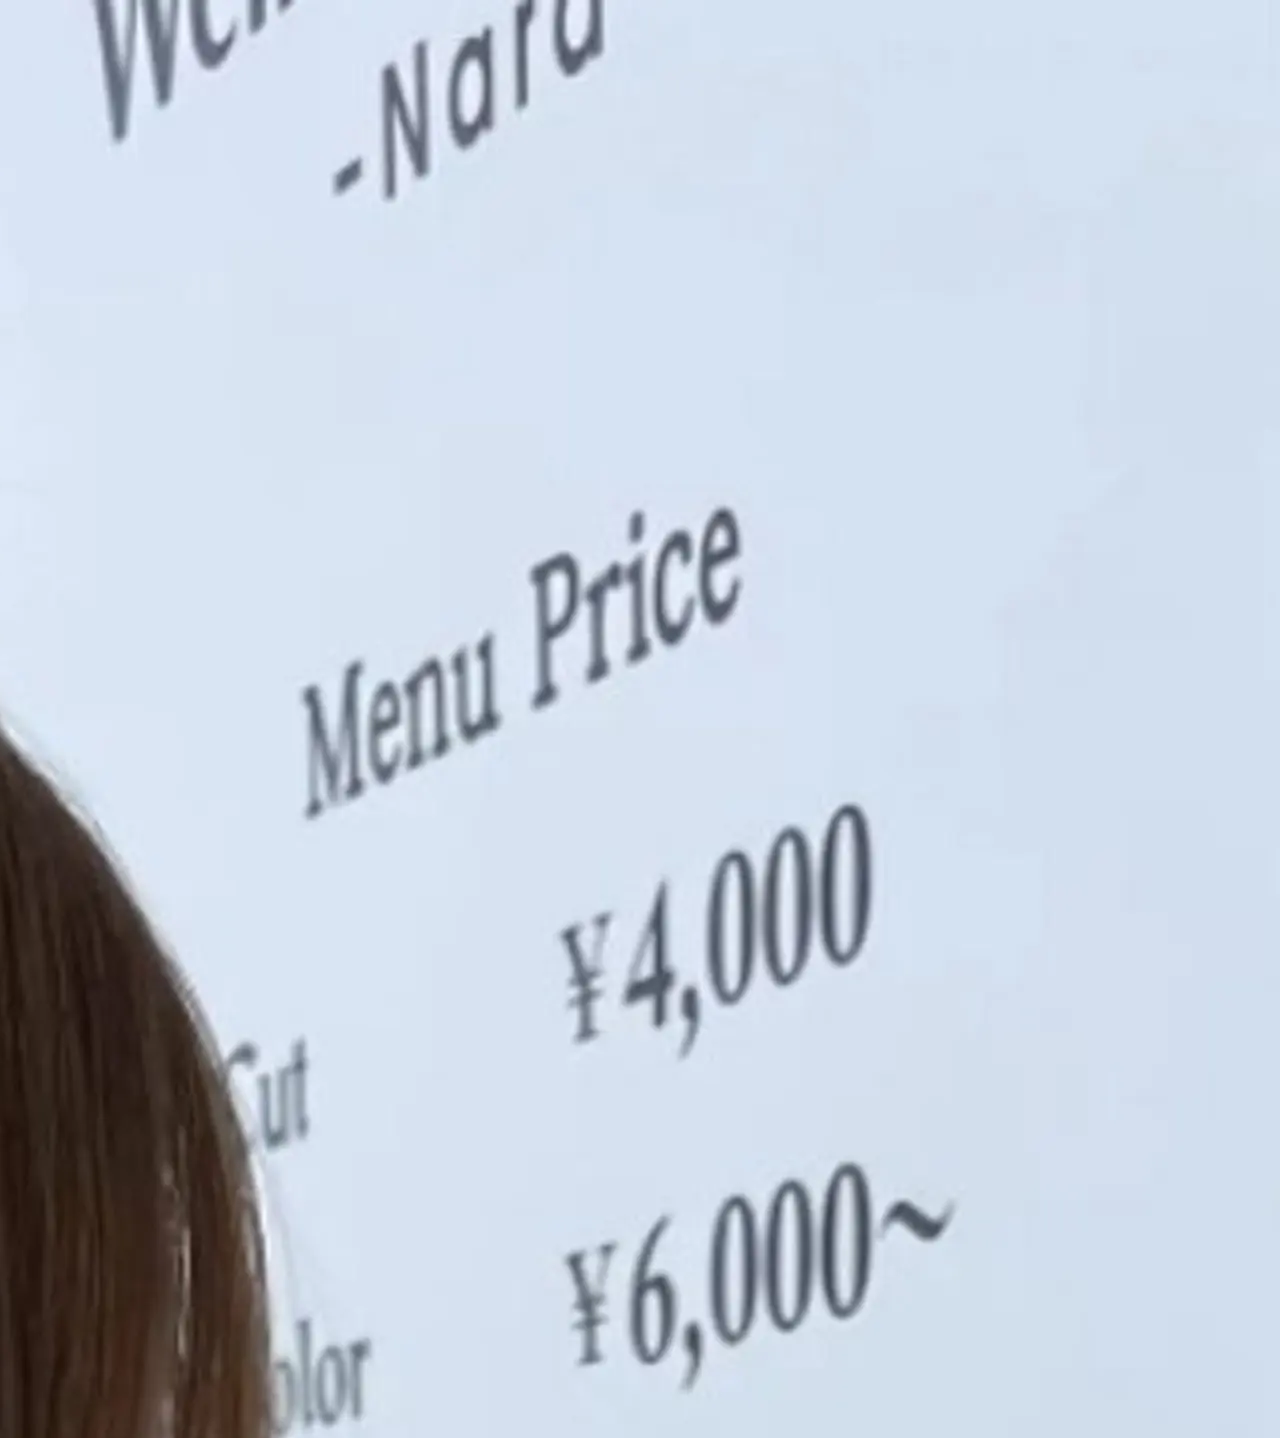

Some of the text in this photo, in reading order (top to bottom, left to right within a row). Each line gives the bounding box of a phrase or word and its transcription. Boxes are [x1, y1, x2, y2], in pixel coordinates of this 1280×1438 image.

[301, 505, 743, 820] Menu Price
[558, 802, 874, 1060] ¥4,000
